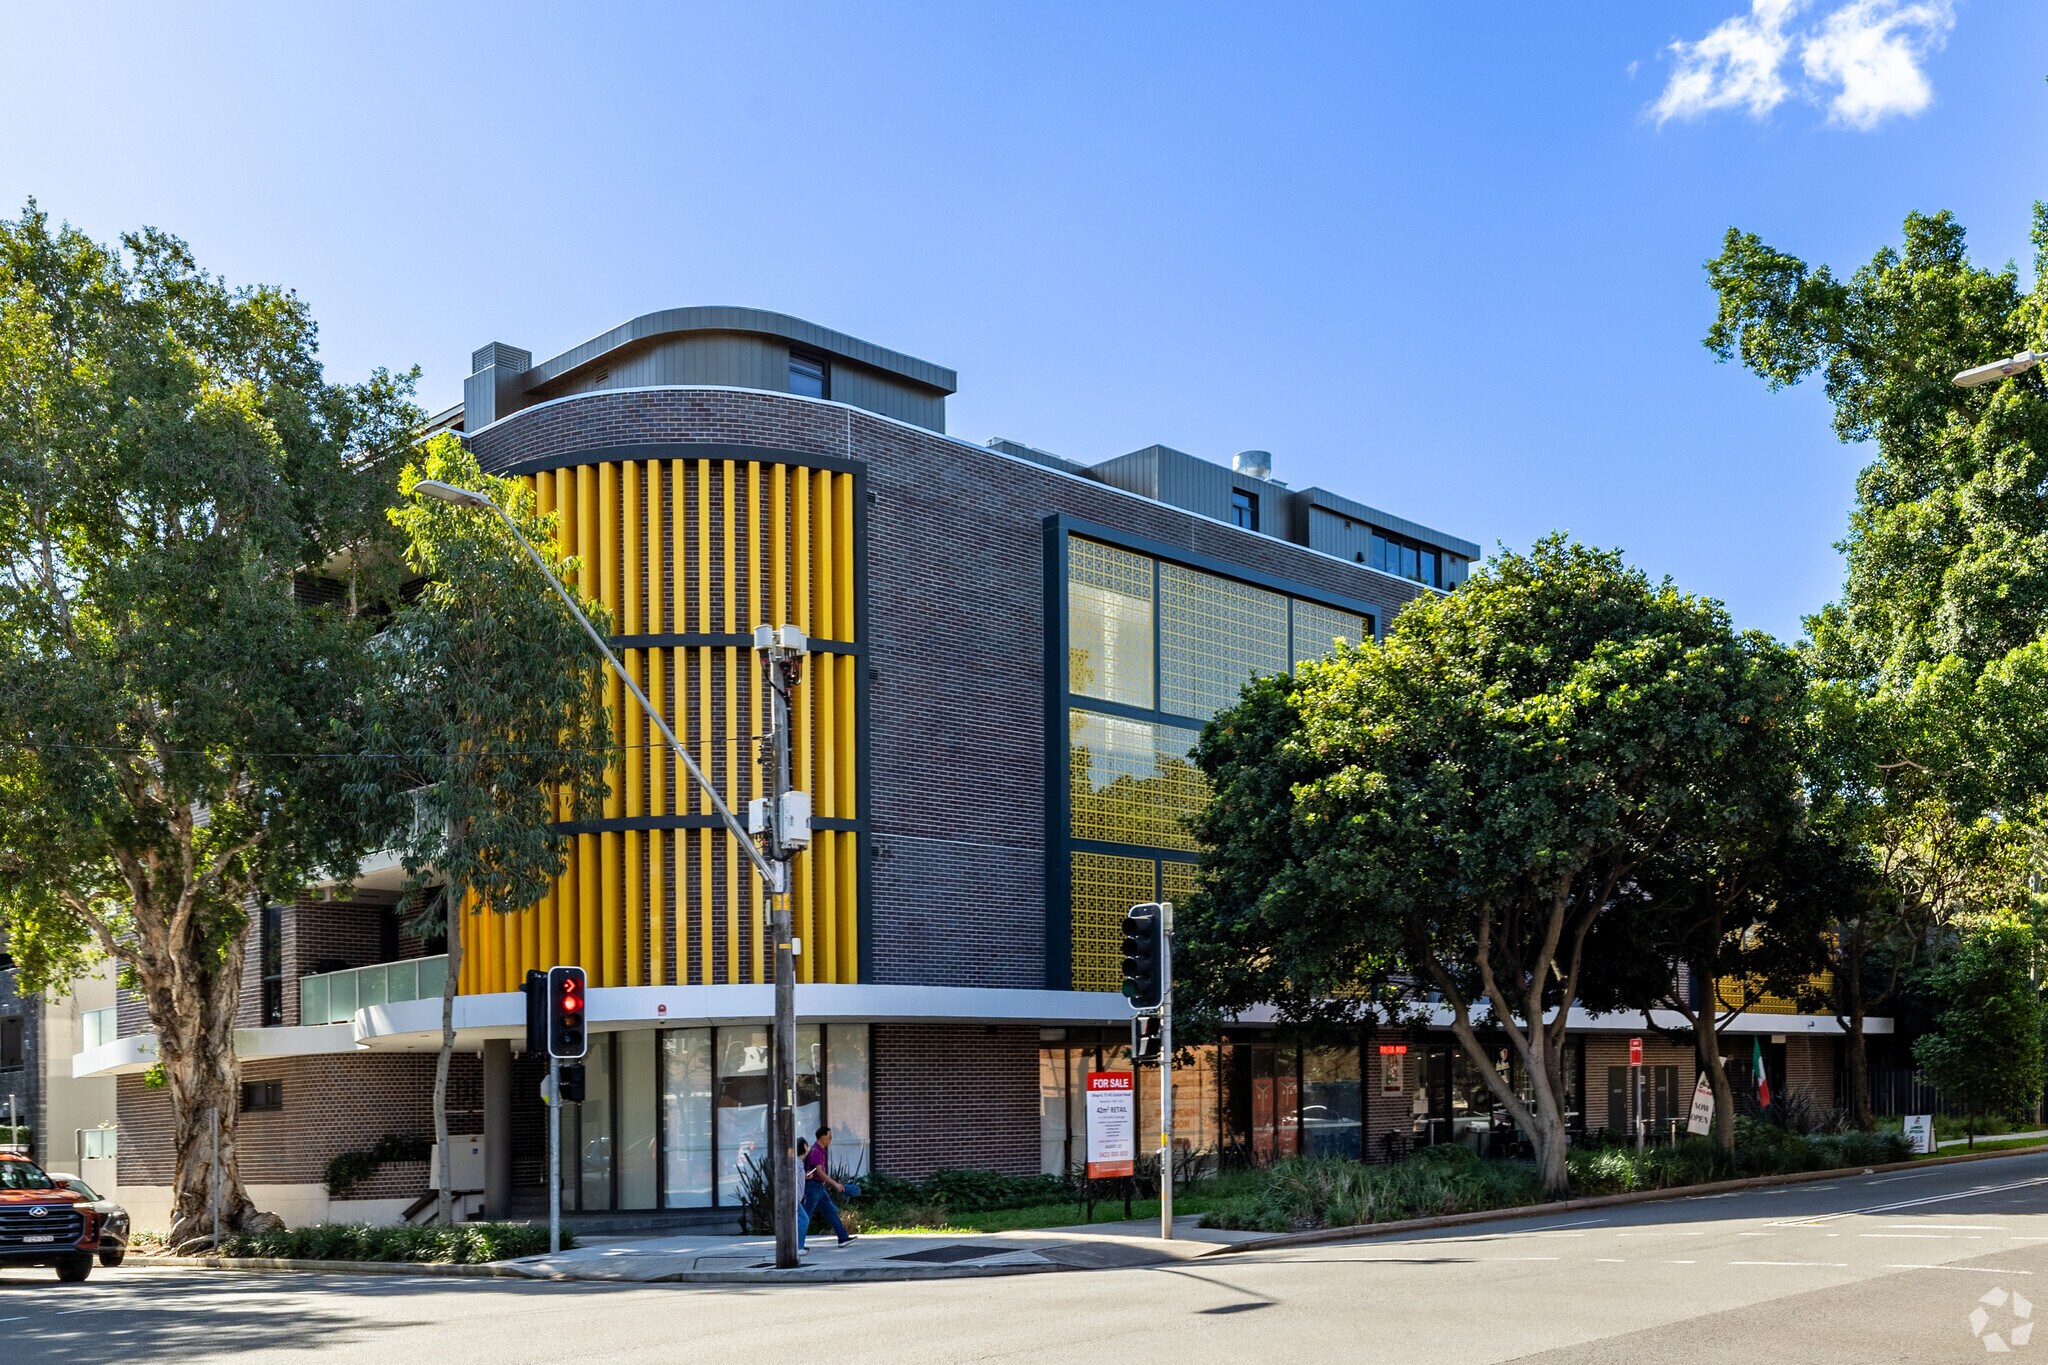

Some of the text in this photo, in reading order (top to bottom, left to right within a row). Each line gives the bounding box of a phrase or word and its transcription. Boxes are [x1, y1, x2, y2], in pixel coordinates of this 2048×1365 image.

[1093, 1078, 1129, 1089] FOR SALE
[1695, 1102, 1710, 1112] NOW
[1690, 1113, 1708, 1124] OPEN
